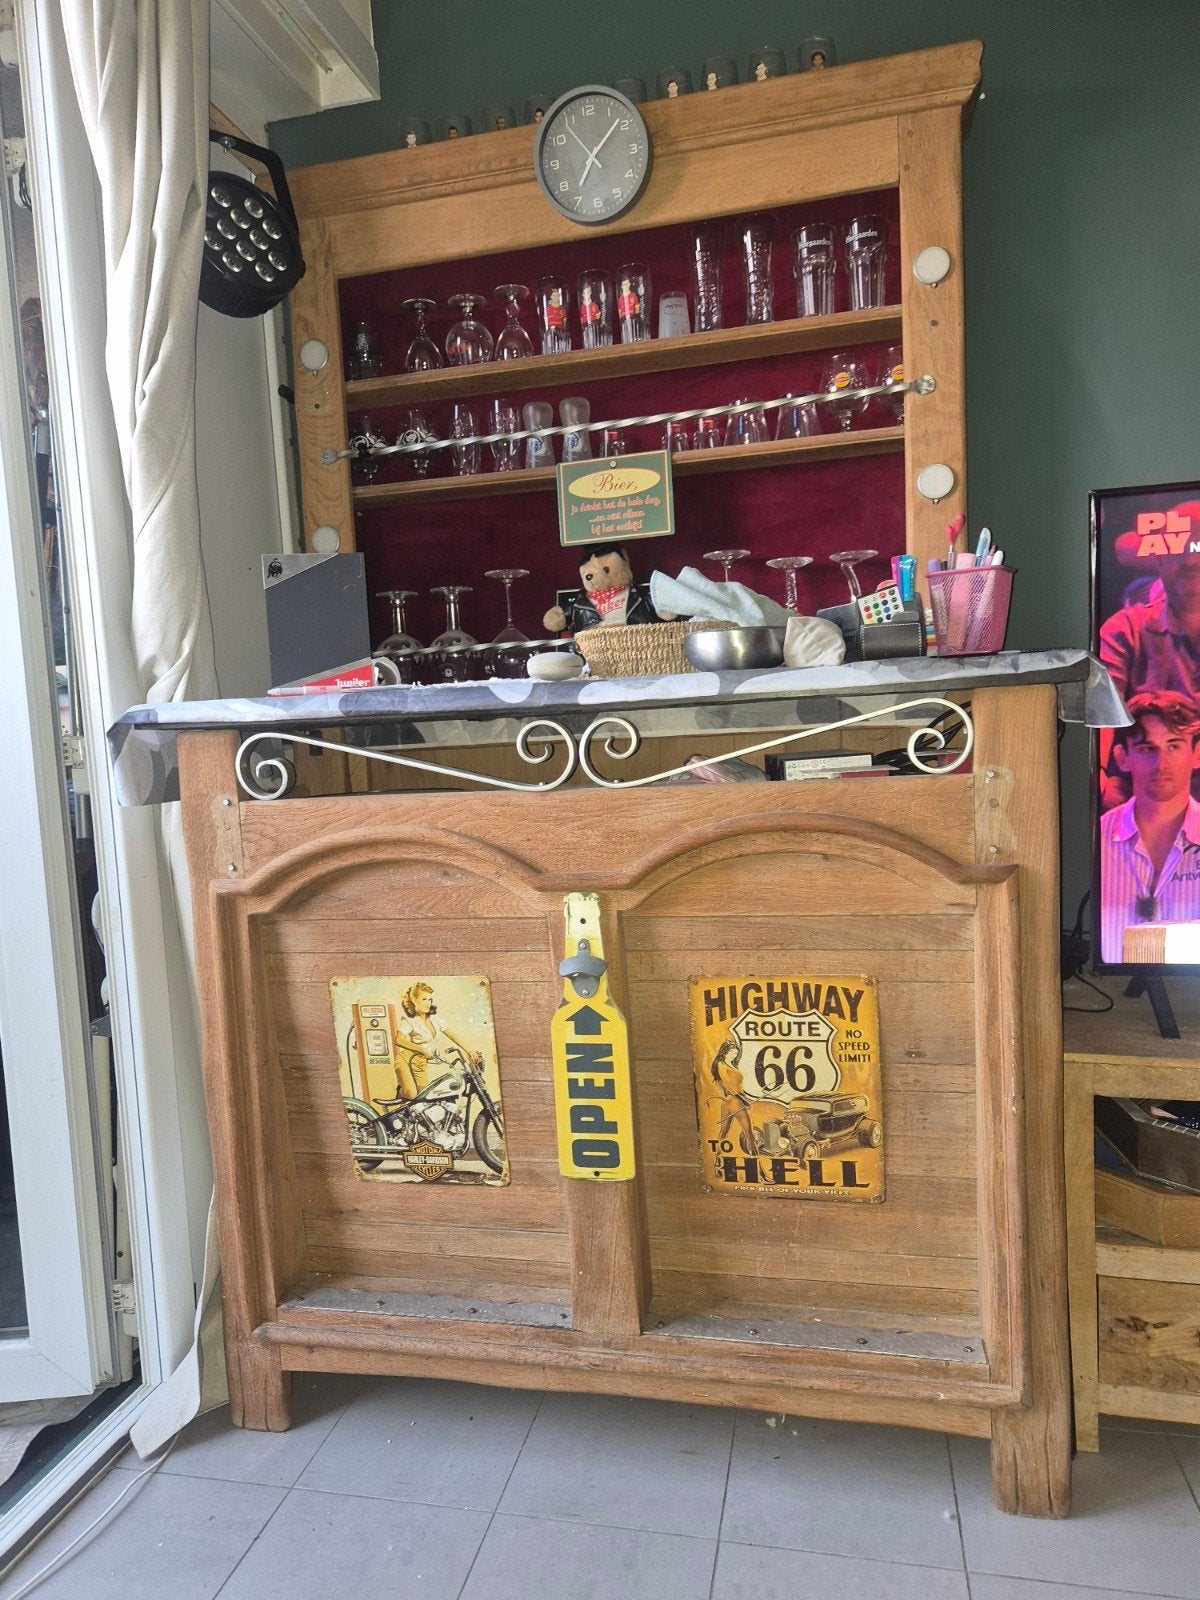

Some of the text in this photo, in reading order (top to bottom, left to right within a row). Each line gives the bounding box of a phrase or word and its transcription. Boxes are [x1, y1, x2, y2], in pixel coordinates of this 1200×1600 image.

[581, 104, 596, 116] 12
[606, 107, 611, 117] 1
[620, 119, 630, 131] 2
[552, 134, 567, 146] 10
[628, 143, 638, 154] 3
[550, 159, 560, 170] 9
[624, 168, 634, 179] 4
[559, 181, 569, 192] 8
[612, 187, 622, 198] 5
[573, 196, 583, 207] 7
[593, 197, 603, 208] 6
[703, 981, 865, 1027] HIGHWAY
[744, 1020, 821, 1037] ROUTE
[845, 1029, 862, 1039] NO
[838, 1041, 870, 1051] SPEED
[754, 1045, 816, 1092] 66
[565, 1042, 621, 1169] OPEN
[707, 1139, 734, 1154] TO
[721, 1157, 871, 1188] HELL
